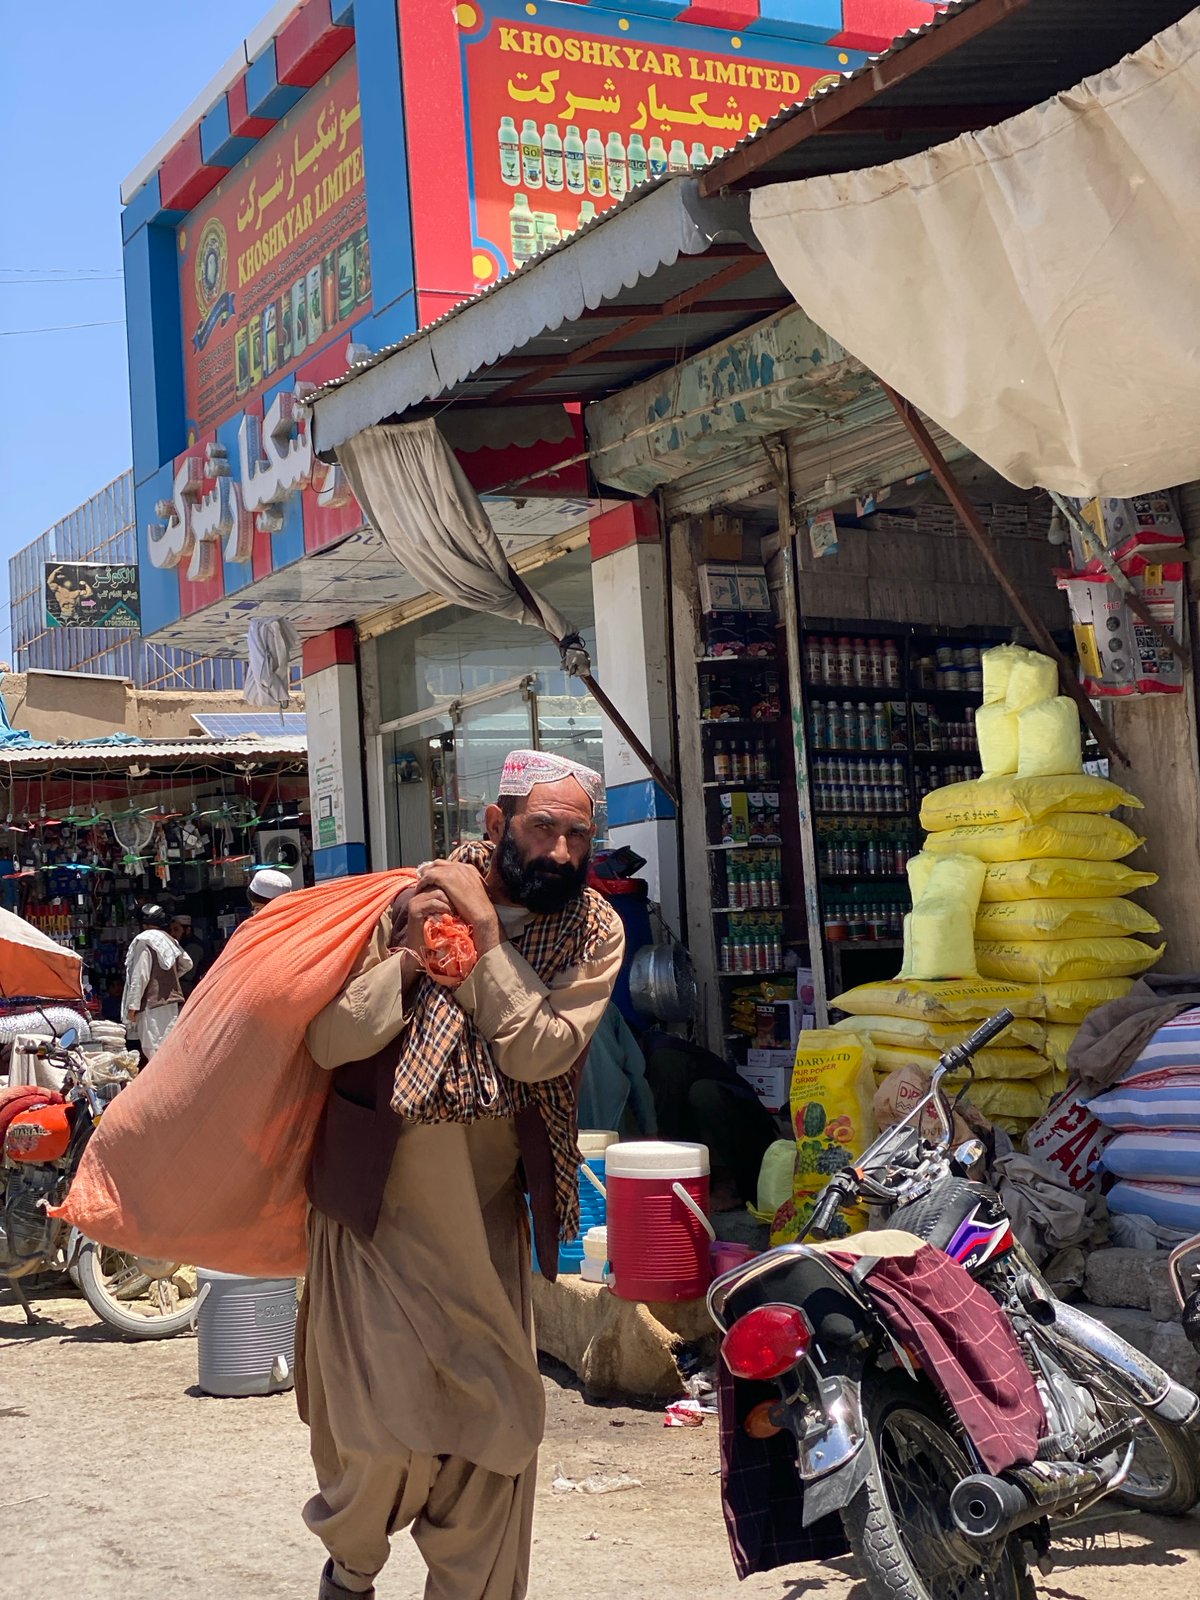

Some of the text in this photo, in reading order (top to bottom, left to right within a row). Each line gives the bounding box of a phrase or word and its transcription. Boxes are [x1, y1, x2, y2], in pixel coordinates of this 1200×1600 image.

[498, 27, 801, 95] KHOSHKYAR LIMITED
[507, 69, 787, 132] وشکیار شرکت
[287, 96, 360, 200] وشکیار
[237, 153, 284, 233] شرکت
[237, 193, 313, 289] KHOSHKYAR
[315, 143, 365, 220] LIMITE
